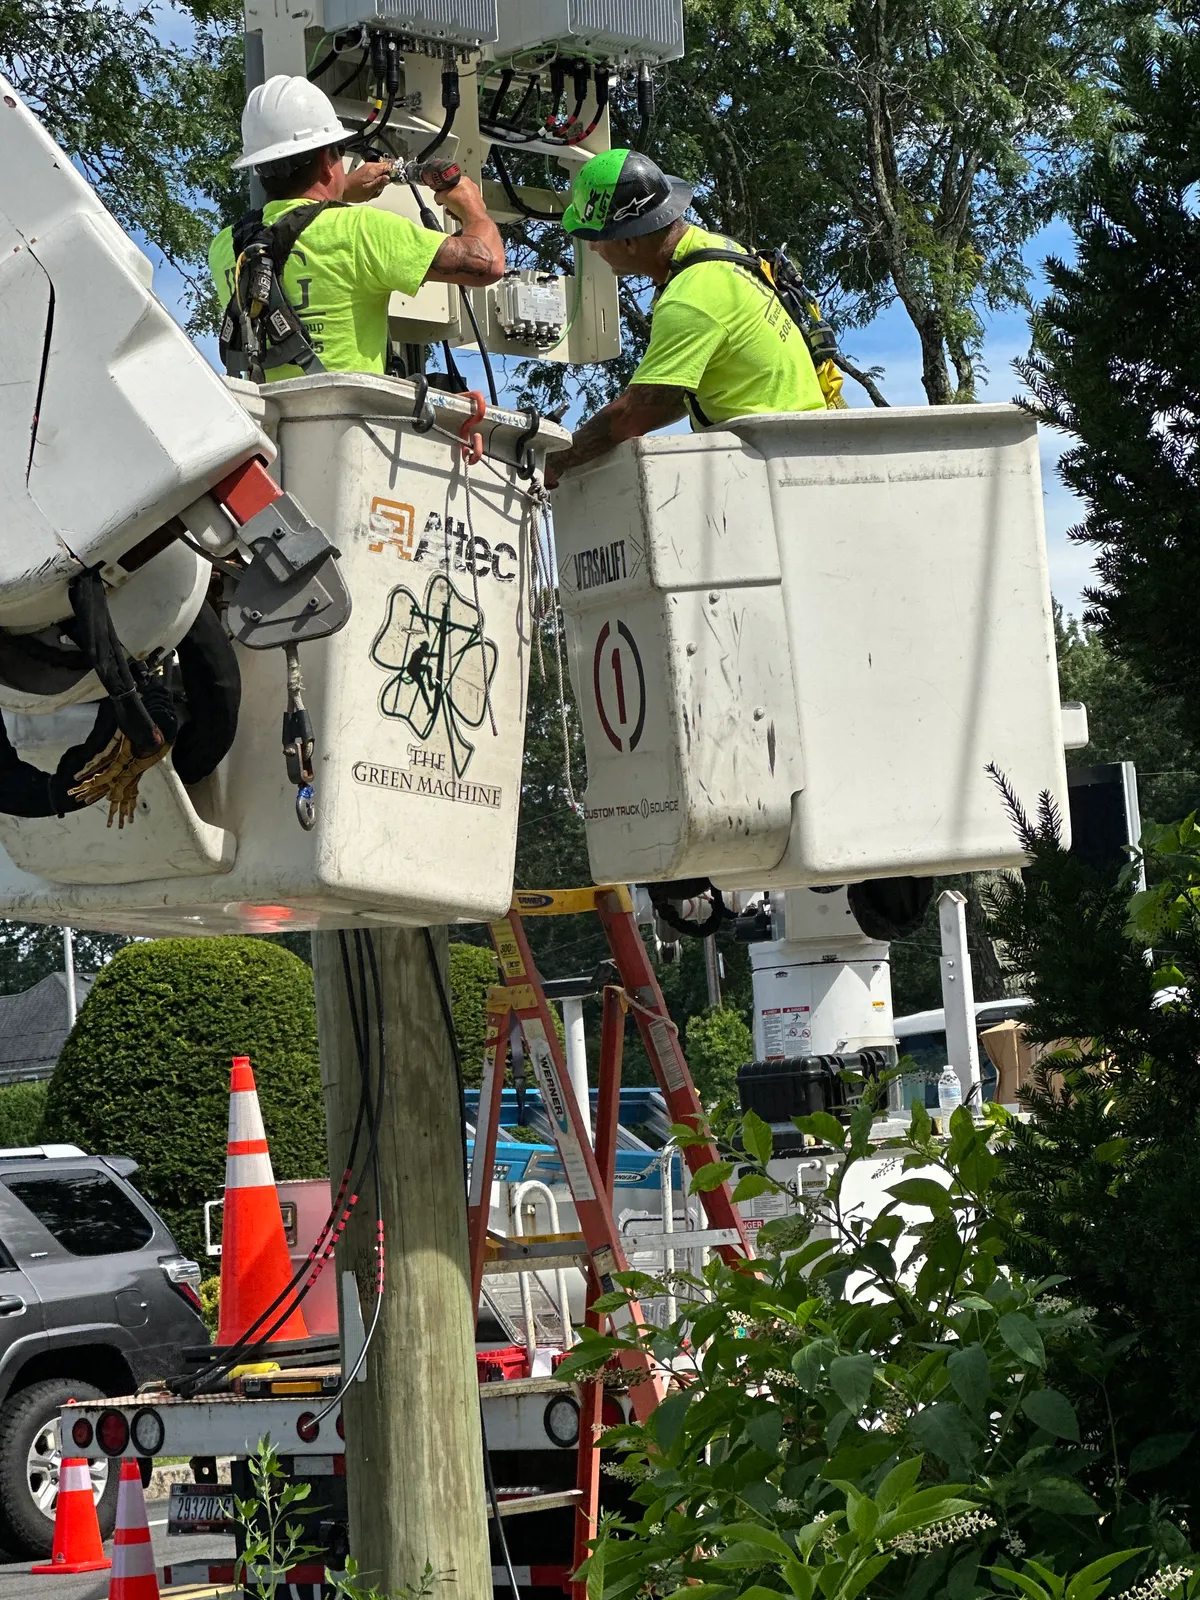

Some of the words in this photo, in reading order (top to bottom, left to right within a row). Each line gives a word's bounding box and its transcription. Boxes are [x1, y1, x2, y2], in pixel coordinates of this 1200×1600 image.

[412, 511, 518, 582] Altec
[573, 539, 627, 591] VERSALIFT
[411, 748, 446, 771] THE
[354, 764, 413, 790] GREEN
[417, 777, 501, 807] MACHINE
[584, 807, 615, 820] CUSTOM
[616, 804, 640, 817] TRUCK
[650, 800, 679, 813] SOURCE
[540, 1055, 564, 1117] WERNER
